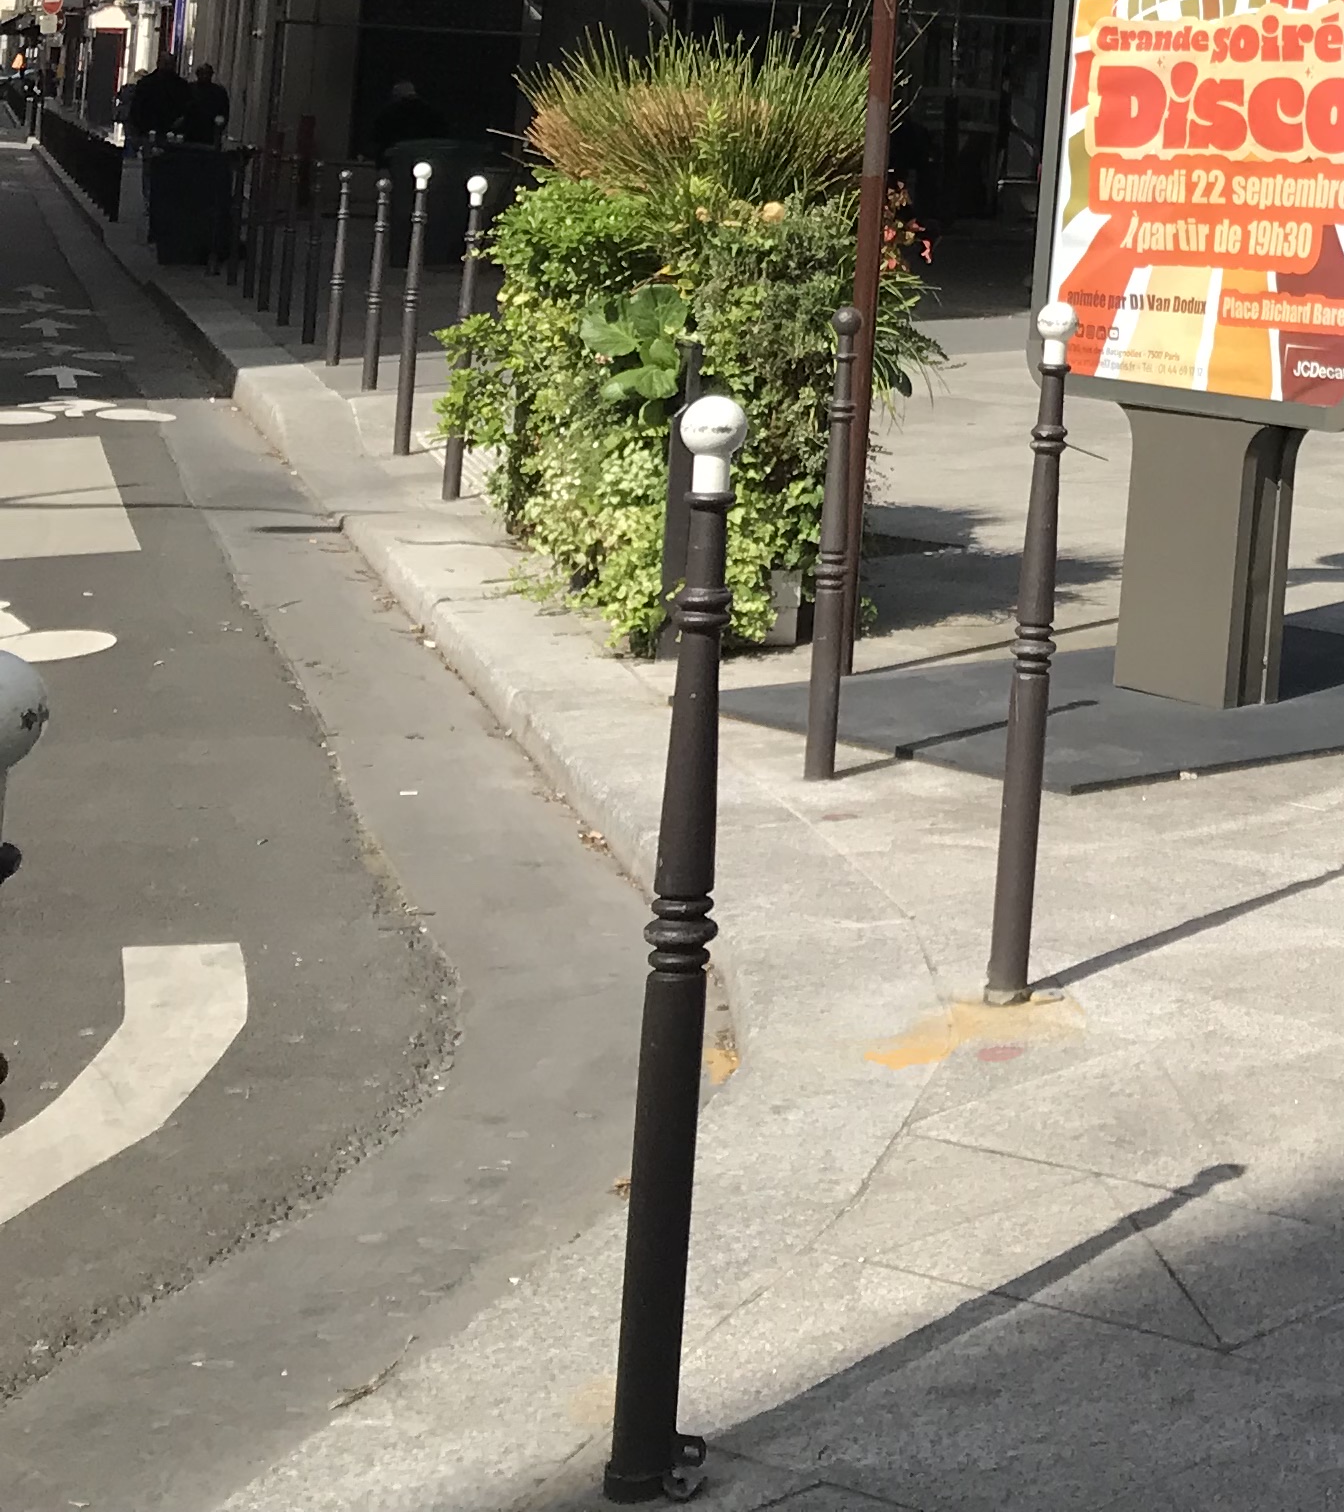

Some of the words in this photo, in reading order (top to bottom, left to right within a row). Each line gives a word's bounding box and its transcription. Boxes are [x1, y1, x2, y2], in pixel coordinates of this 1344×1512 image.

[1096, 25, 1210, 53] Grande
[1099, 167, 1186, 204] Vendredi
[1191, 169, 1226, 205] 22
[1119, 210, 1140, 249] À
[1137, 217, 1210, 254] partir
[1214, 219, 1241, 255] de
[1248, 220, 1313, 259] 19h30
[1067, 289, 1107, 308] animée
[1107, 294, 1126, 310] par
[1130, 293, 1144, 311] DJ
[1147, 294, 1170, 312] Van
[1172, 295, 1207, 315] Dodux
[1222, 296, 1259, 320] Place
[1261, 299, 1311, 324] Richard
